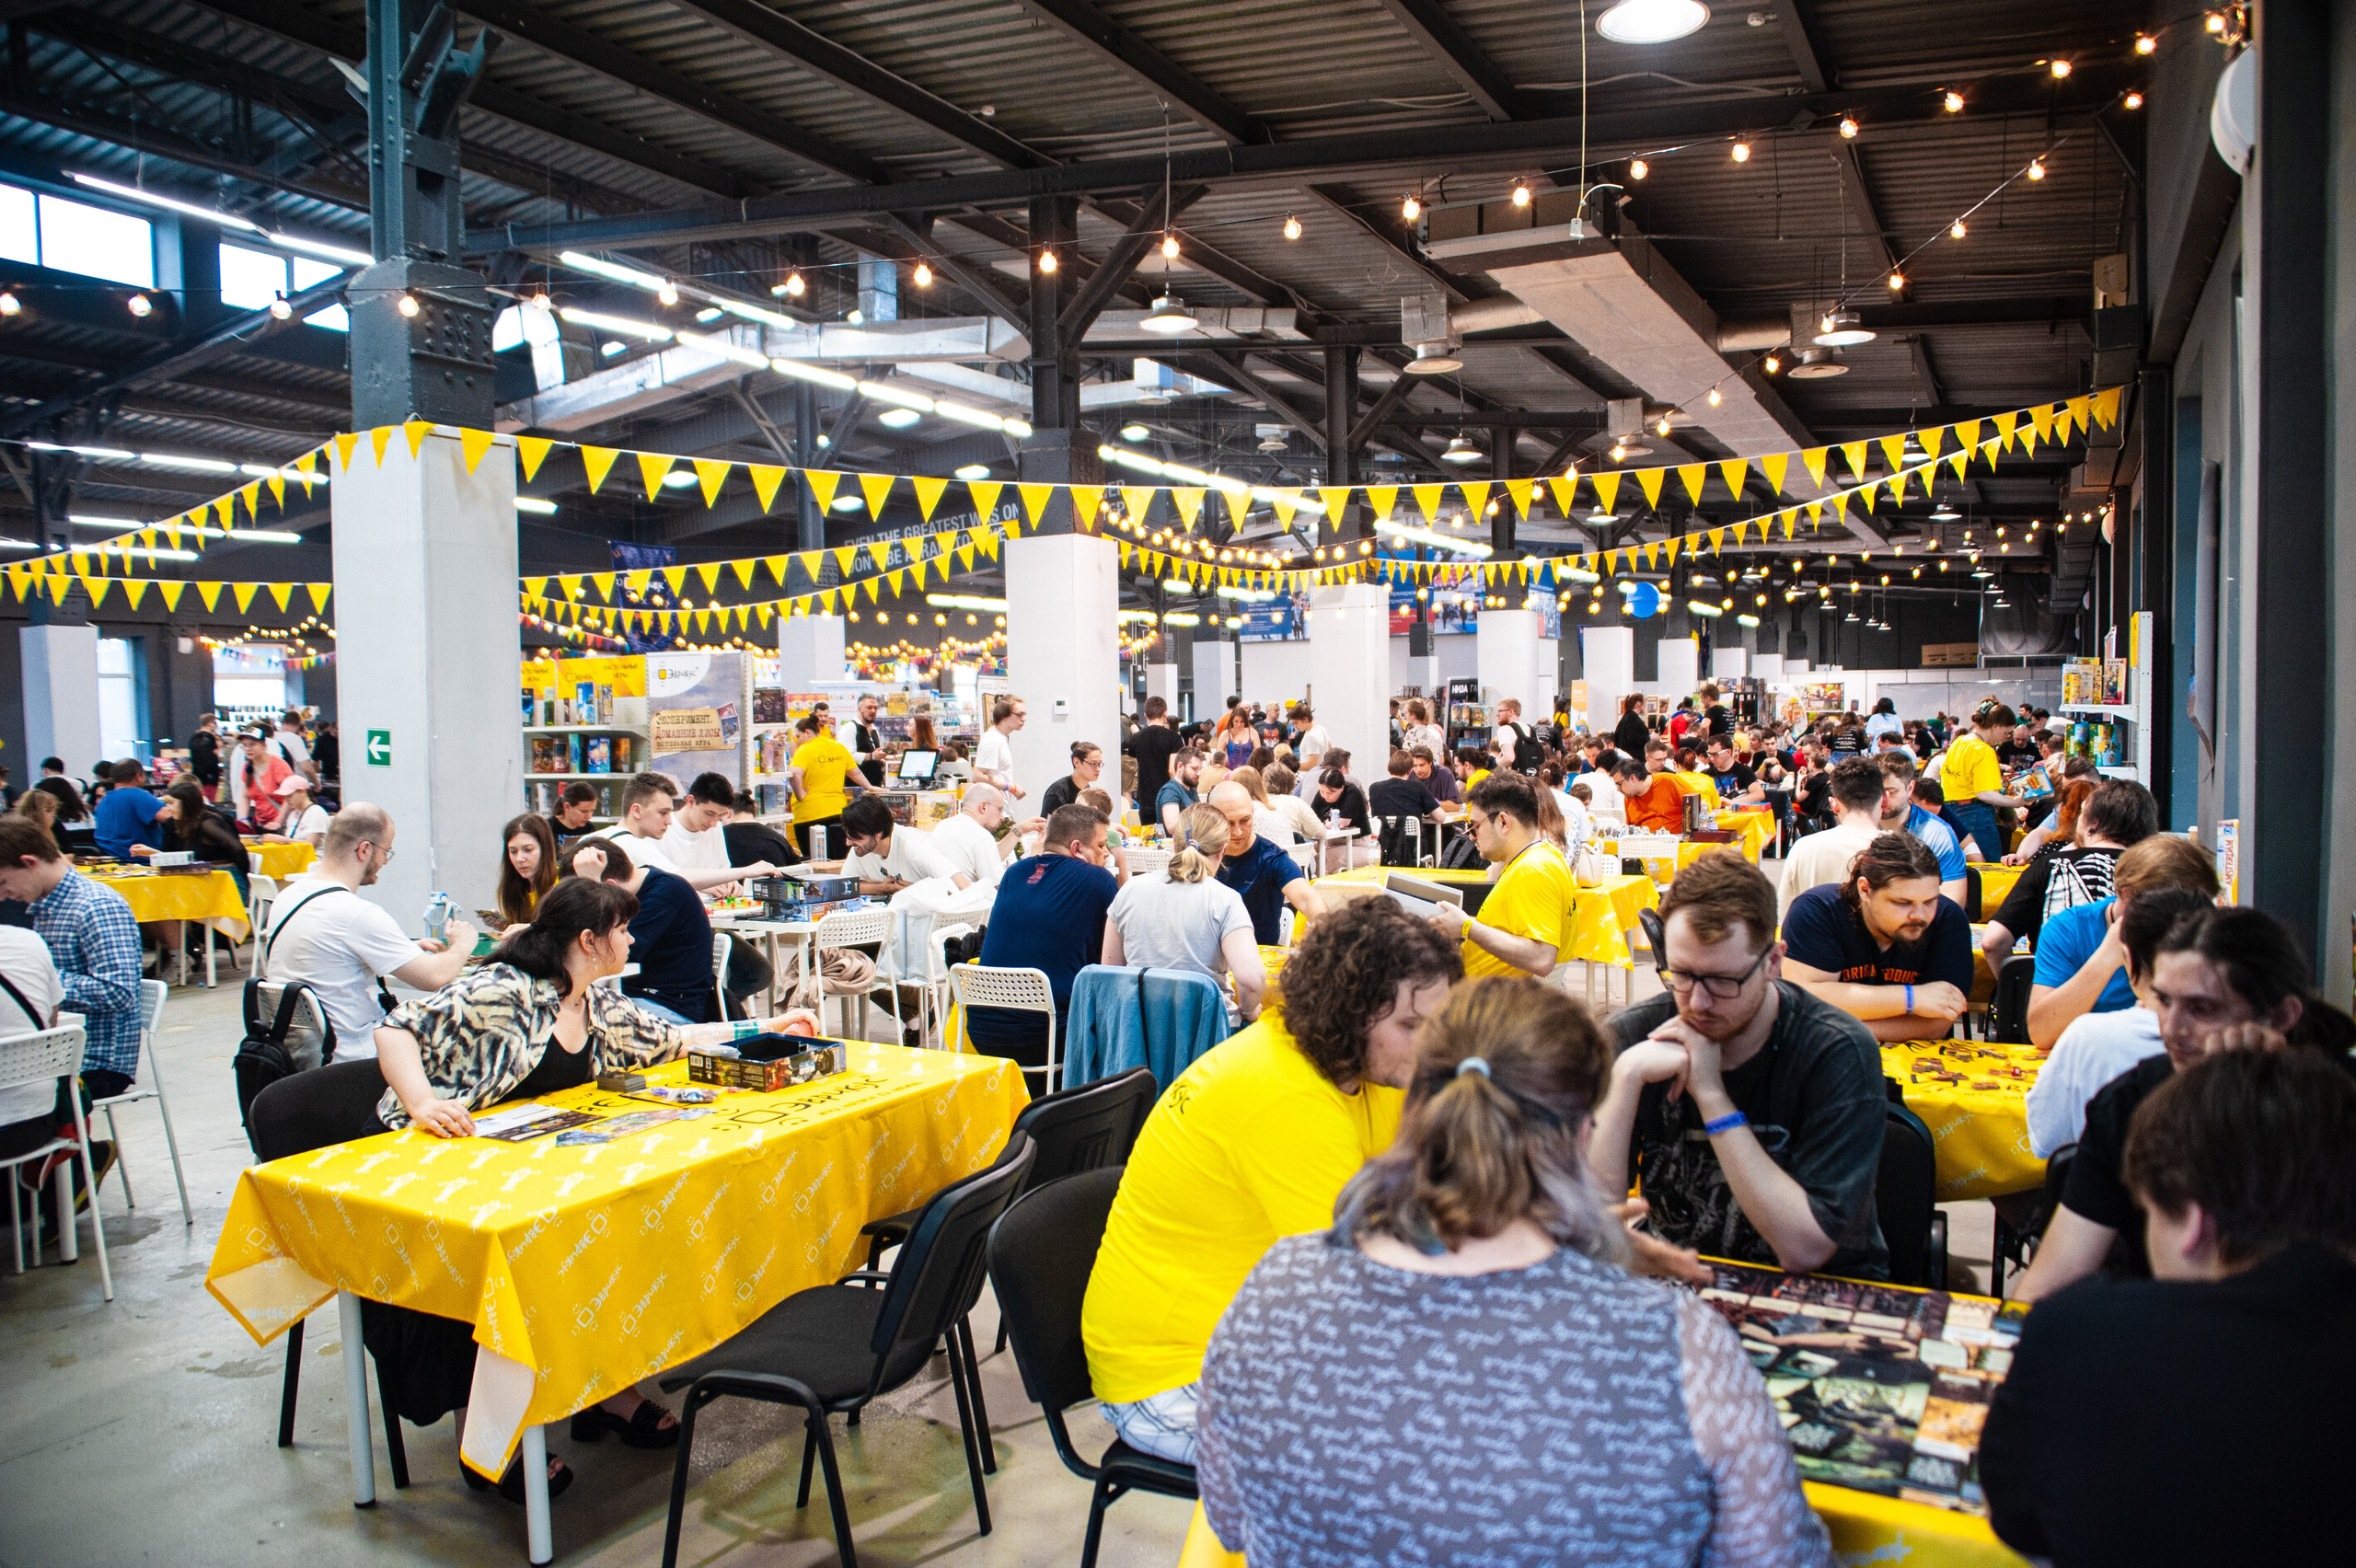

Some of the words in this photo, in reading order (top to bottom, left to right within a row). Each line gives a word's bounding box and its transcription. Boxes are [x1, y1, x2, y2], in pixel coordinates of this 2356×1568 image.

[904, 513, 966, 537] GREATEST
[887, 548, 902, 567] BE
[1451, 684, 1468, 694] НИЗА
[2224, 839, 2235, 886] AMSTERDAM
[768, 1075, 889, 1112] Эврикус
[661, 1170, 691, 1213] Эврикус
[806, 1161, 834, 1199] Эврикус
[701, 1182, 731, 1222] Эврикус
[558, 1228, 596, 1277] Эврикус
[712, 1236, 740, 1276] Эврикус
[591, 1264, 622, 1311] Эврикус
[633, 1271, 668, 1320] Эврикус
[484, 1297, 506, 1355] Эврикус
[647, 1328, 685, 1375] Эврикус
